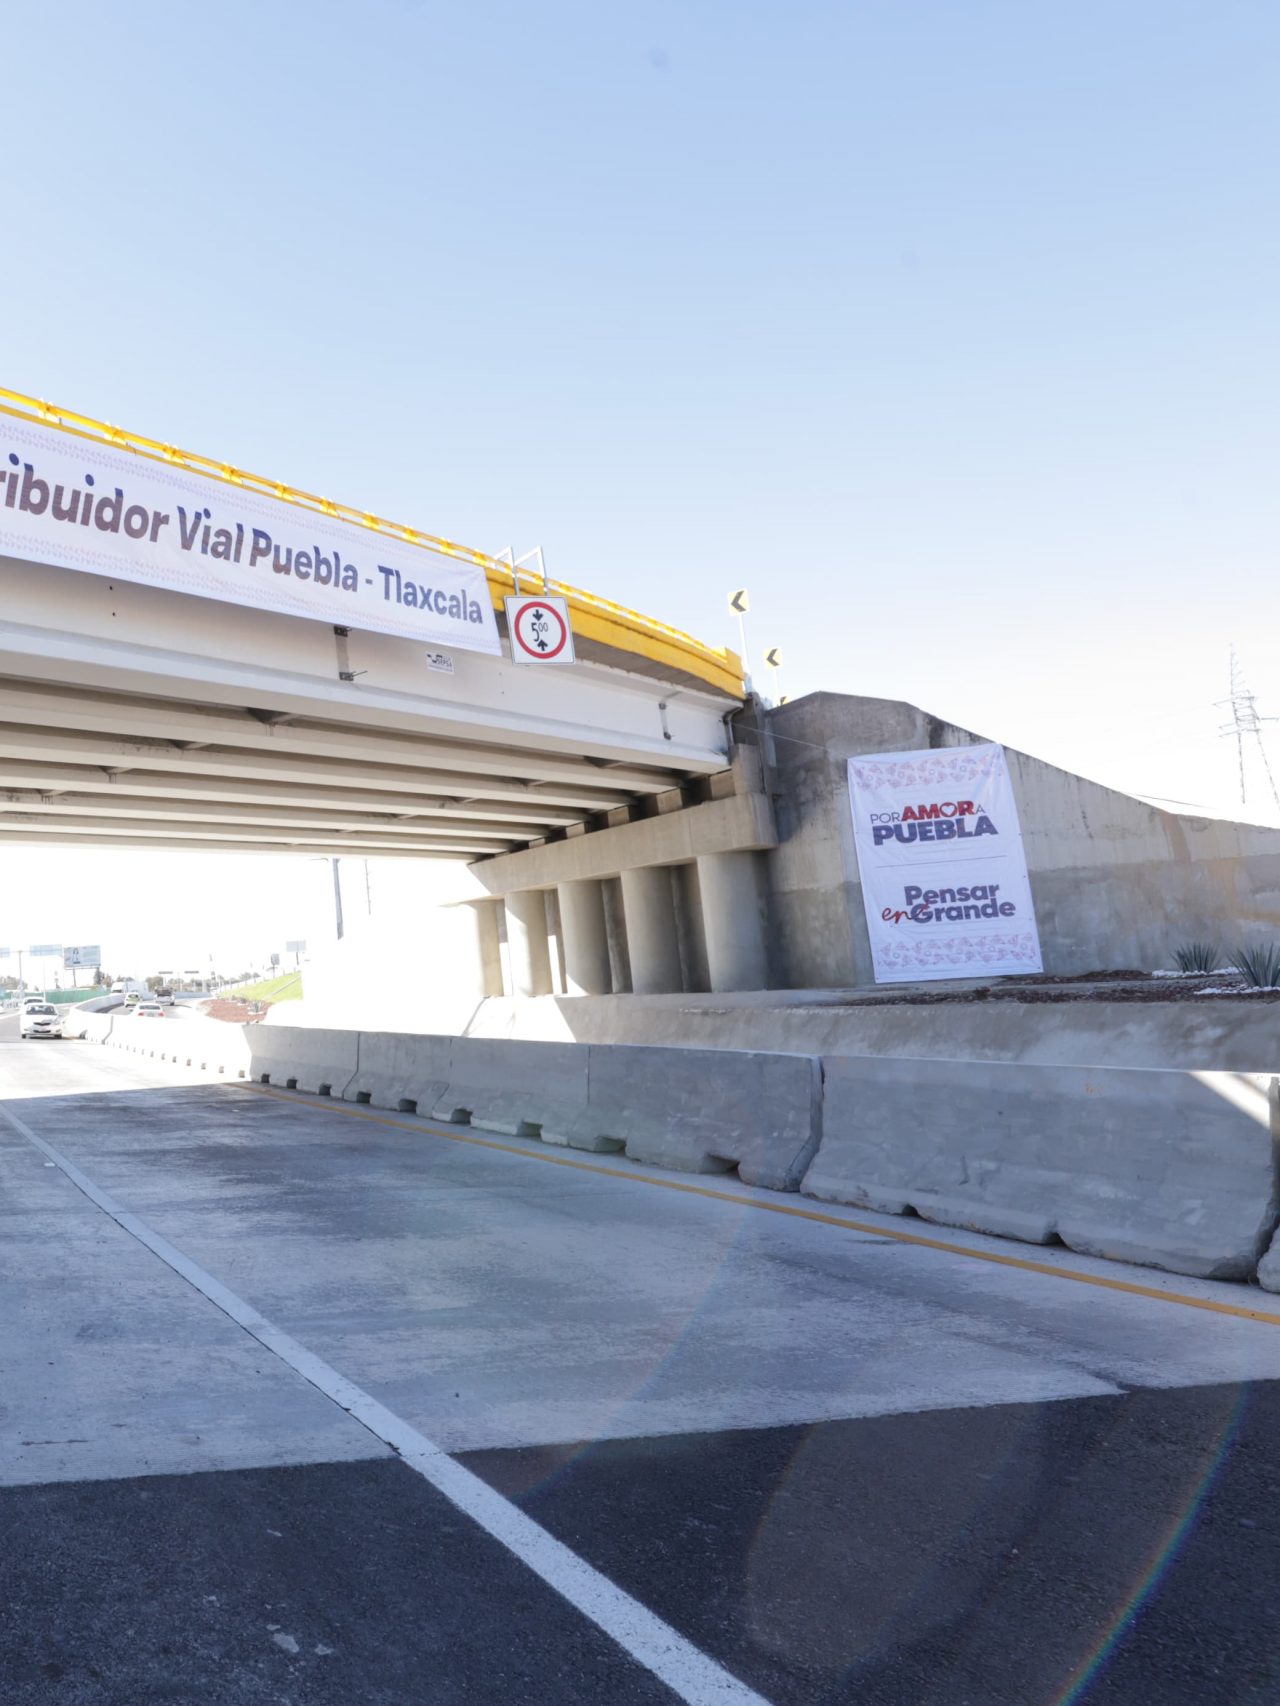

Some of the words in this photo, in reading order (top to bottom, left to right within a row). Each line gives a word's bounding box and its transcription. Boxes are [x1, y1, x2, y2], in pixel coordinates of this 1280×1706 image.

[178, 505, 244, 563] Vial
[250, 528, 359, 592] Puebla
[378, 565, 483, 625] Tlaxcala
[870, 811, 902, 824] POR
[902, 800, 975, 821] AMOR
[976, 804, 985, 814] A
[872, 815, 999, 846] PUEBLA
[904, 884, 1000, 906] Pensar
[882, 905, 917, 924] en
[910, 897, 1016, 924] Grande
